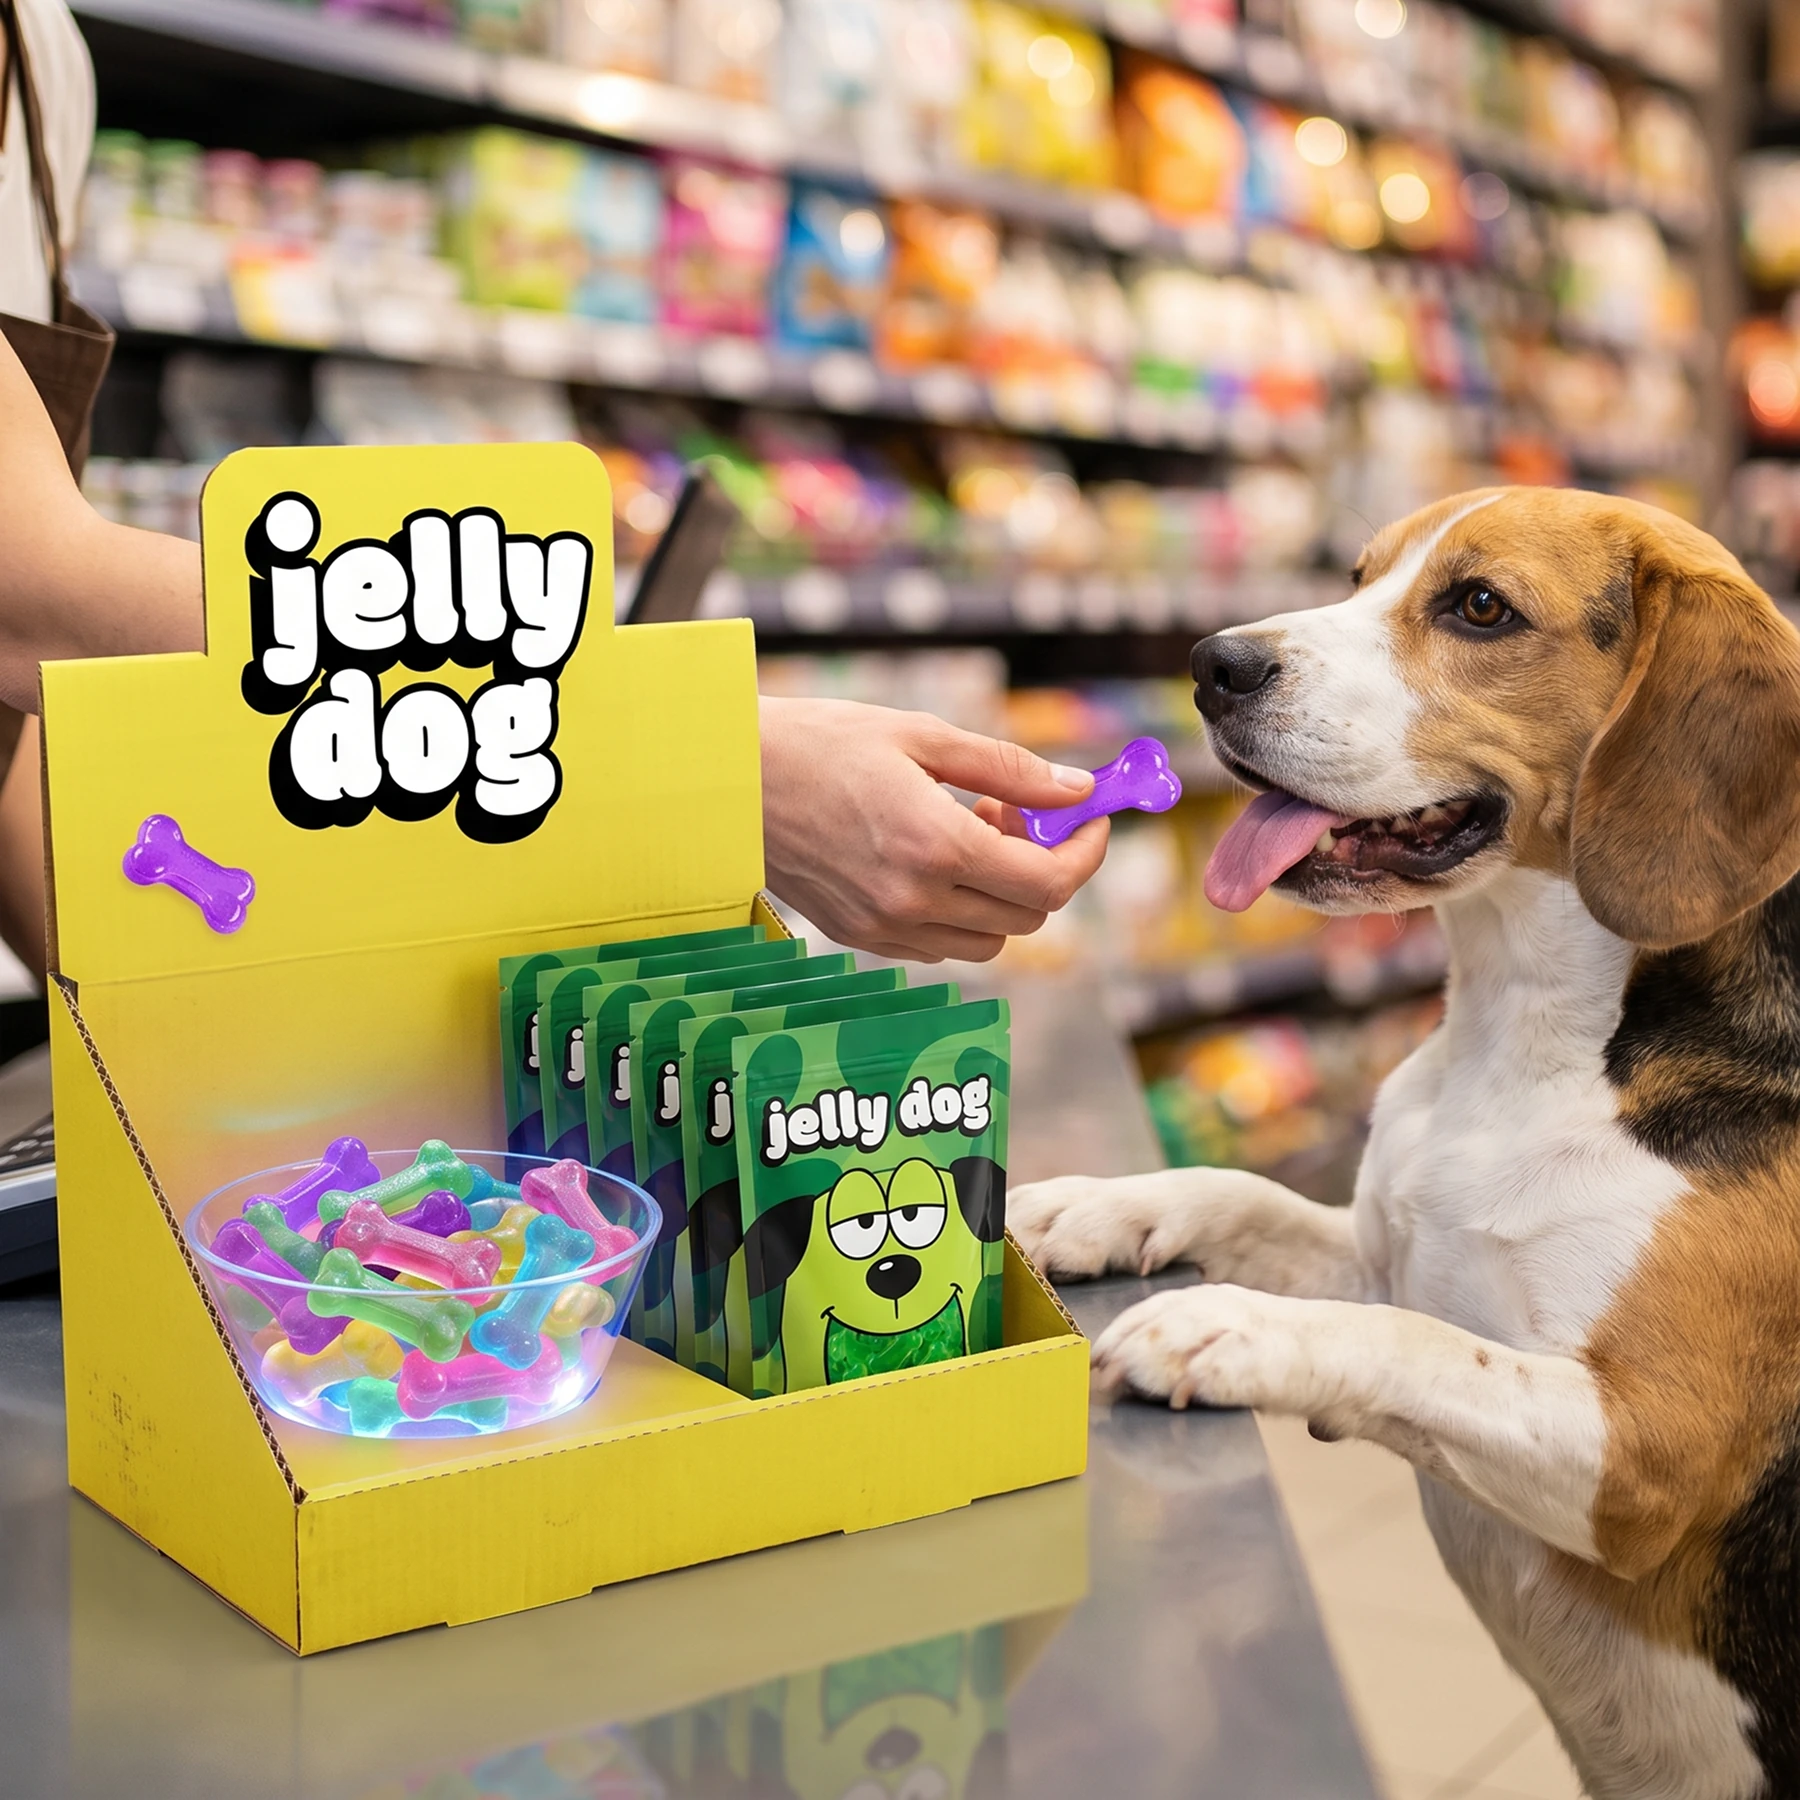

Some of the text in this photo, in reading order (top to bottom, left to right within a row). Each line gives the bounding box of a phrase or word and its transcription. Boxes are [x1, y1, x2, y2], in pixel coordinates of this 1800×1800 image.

[242, 491, 594, 715] jelly
[269, 668, 563, 844] dog
[761, 1087, 890, 1166] jelly
[897, 1074, 992, 1136] dog
